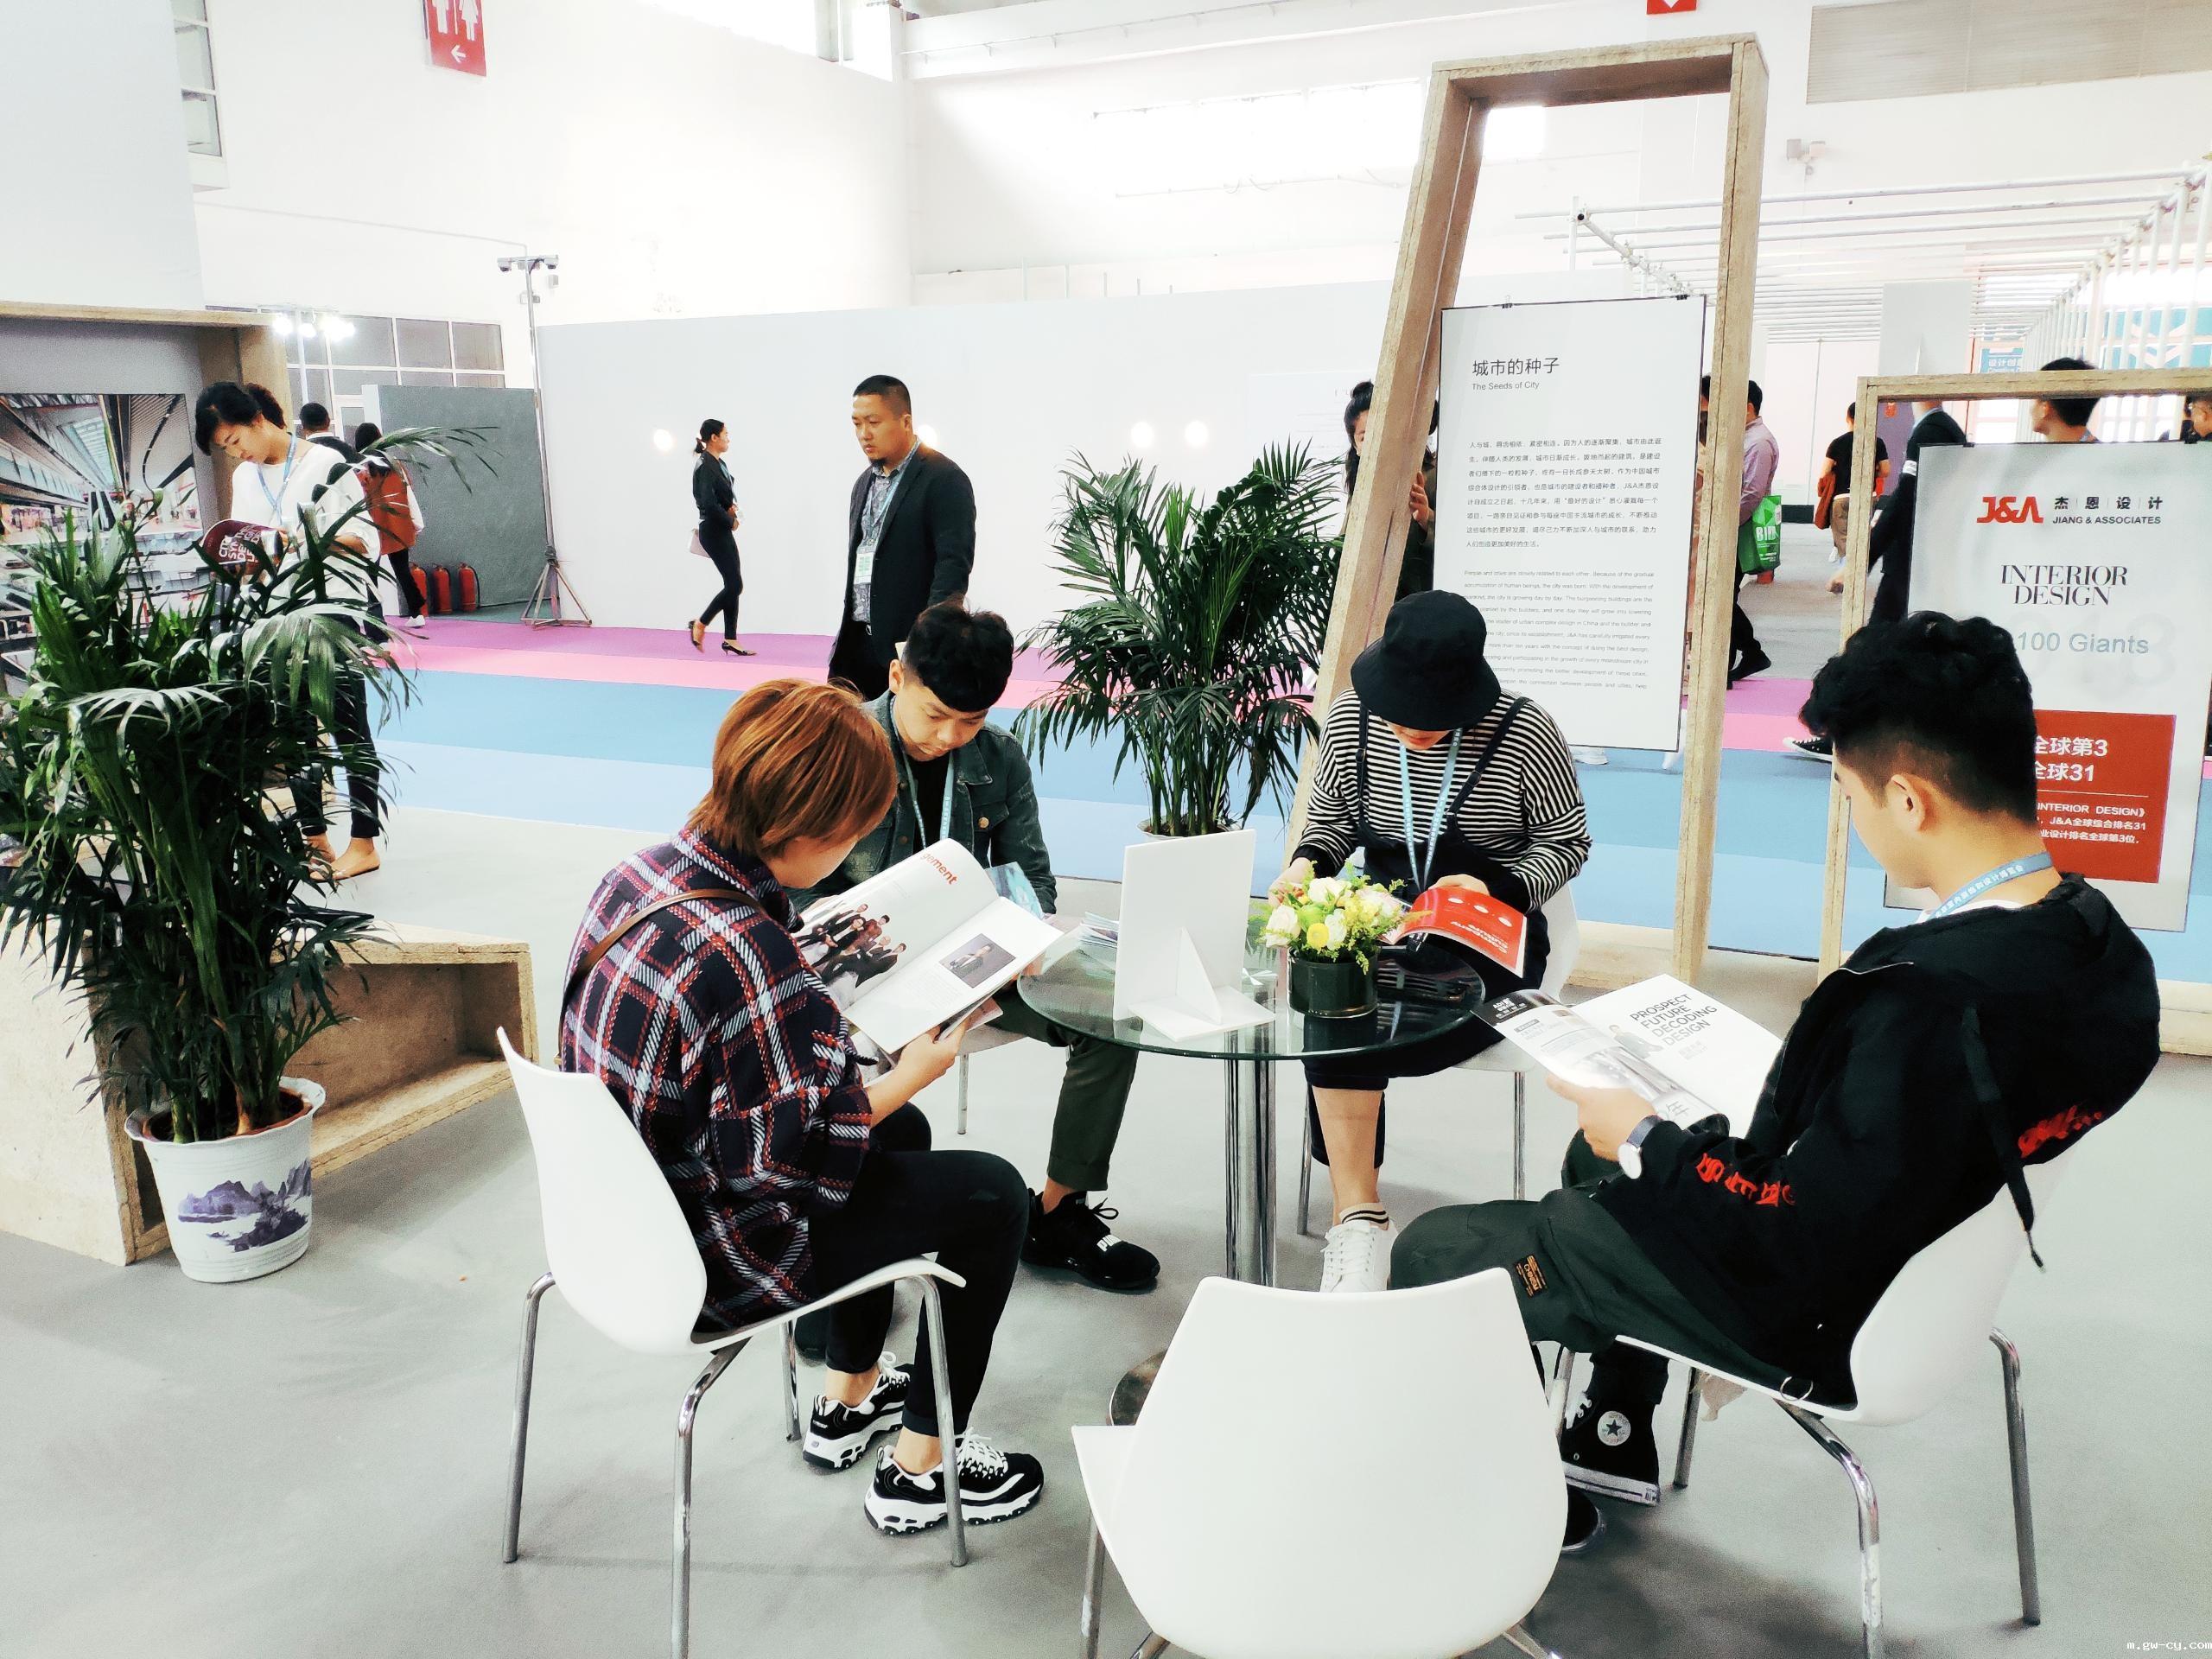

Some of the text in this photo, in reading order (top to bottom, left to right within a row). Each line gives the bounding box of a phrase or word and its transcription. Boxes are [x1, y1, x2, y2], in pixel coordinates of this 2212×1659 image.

[1472, 357, 1560, 376] 城市的种子
[1489, 382, 1513, 390] Seeds
[1525, 381, 1539, 390] City
[1977, 496, 2044, 523] J&A
[2094, 516, 2161, 524] ASSOCIATES
[2001, 565, 2128, 586] INTERIOR
[2014, 585, 2112, 606] DESIGN
[2017, 632, 2150, 655] 100 Giants
[1630, 994, 1691, 1021] PROSPECT
[1640, 1005, 1691, 1029] FUTURE
[1652, 1006, 1717, 1037] DECODING
[1662, 1019, 1711, 1046] DESIGN
